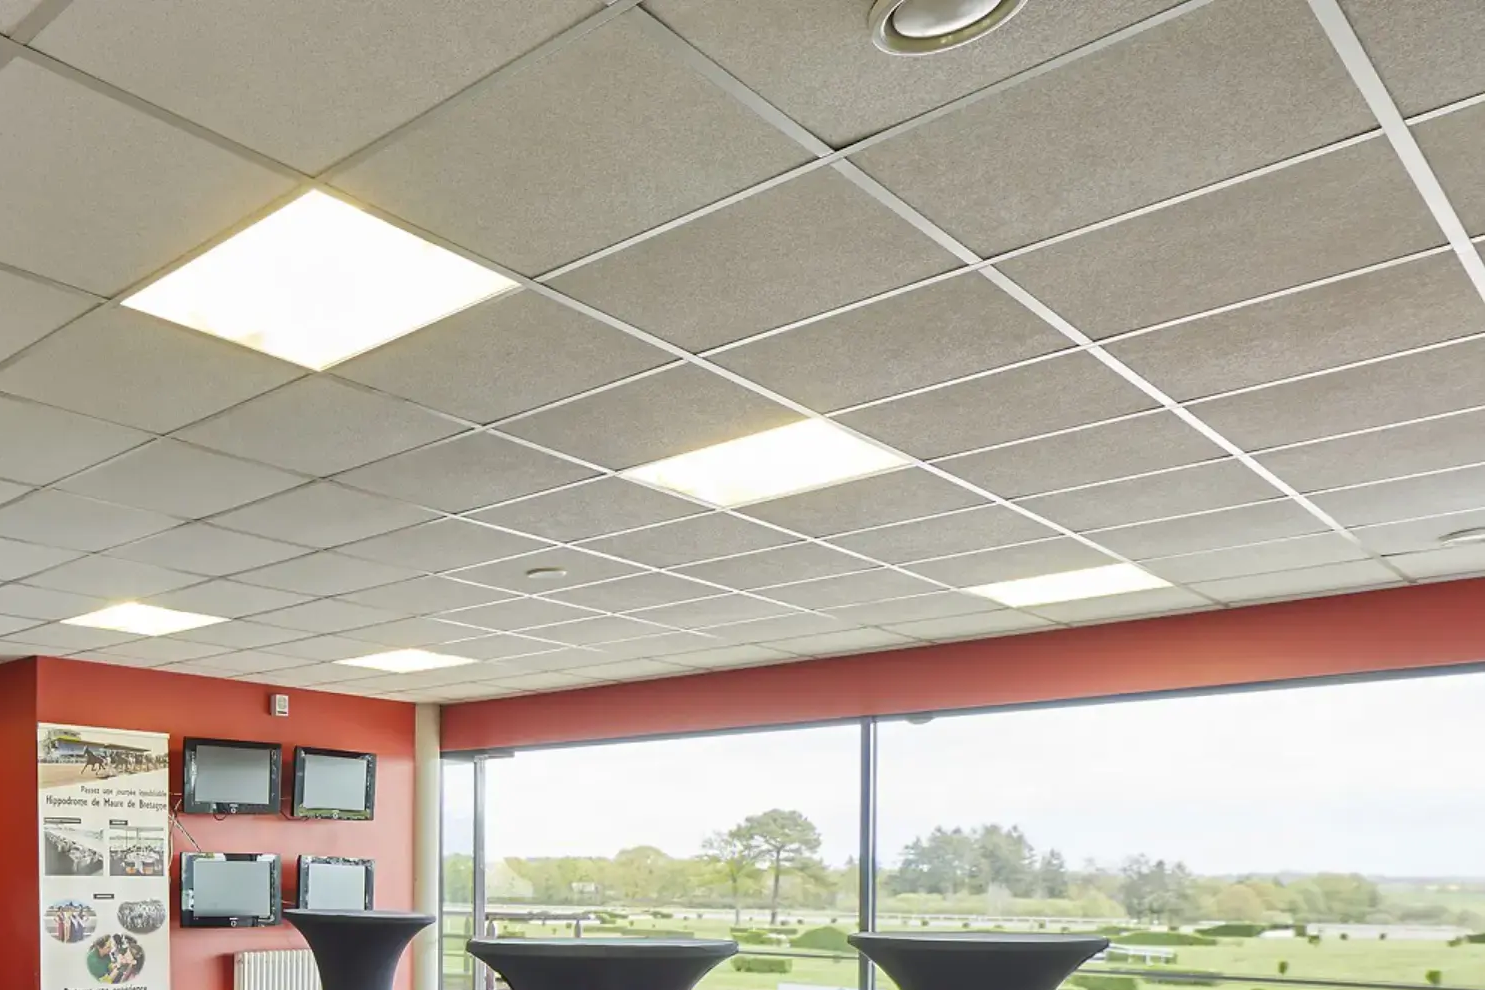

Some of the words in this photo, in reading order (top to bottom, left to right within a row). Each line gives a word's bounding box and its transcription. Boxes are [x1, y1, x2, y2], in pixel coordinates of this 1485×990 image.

[80, 785, 100, 795] Passez
[46, 794, 88, 807] Hippodrome
[91, 798, 100, 807] de
[103, 797, 124, 808] Maure
[127, 799, 136, 809] de
[139, 798, 167, 811] Bretagne
